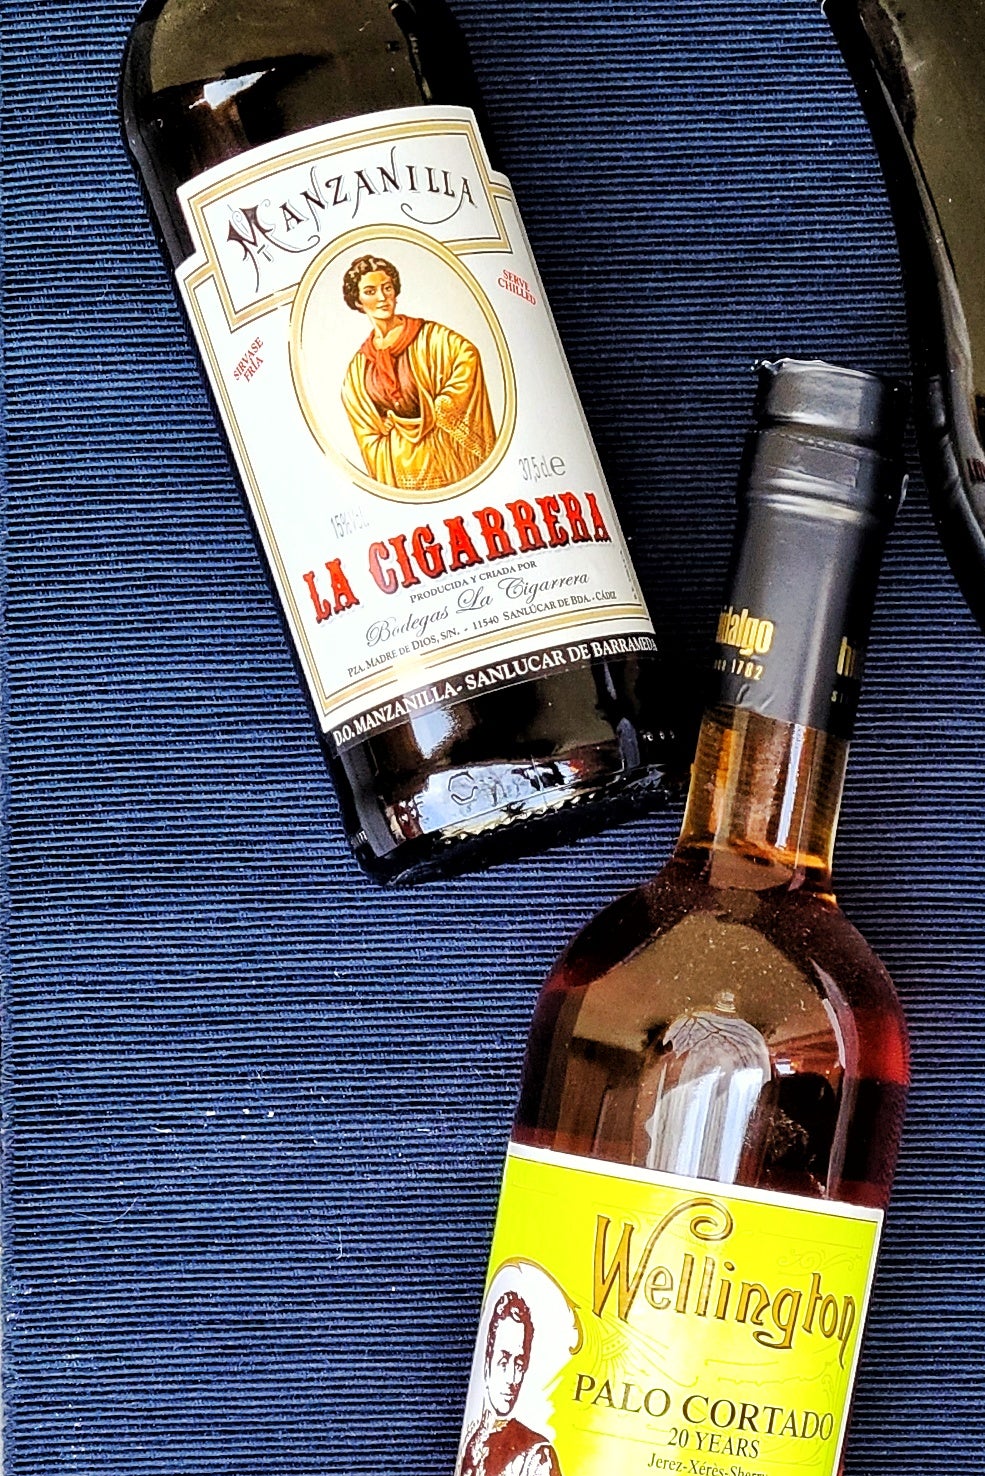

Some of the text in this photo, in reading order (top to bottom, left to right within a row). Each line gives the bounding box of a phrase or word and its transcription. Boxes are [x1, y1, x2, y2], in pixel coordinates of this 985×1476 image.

[226, 145, 478, 290] MANZANILLA
[498, 277, 537, 305] CHILLED
[503, 269, 531, 292] SERVE
[233, 336, 264, 381] SIRVASE
[302, 558, 361, 624] LA
[367, 491, 612, 595] CIGARRERA
[410, 559, 538, 603] PRODUCIDA Y CRIADA POR
[365, 649, 397, 669] MADRE
[411, 635, 440, 650] DIOS,
[472, 615, 500, 630] 11540
[502, 601, 557, 621] SANLÚCAR
[557, 597, 570, 608] DE
[366, 605, 449, 647] Bodegas
[455, 586, 493, 613] La
[498, 572, 590, 604] Cigarrera
[332, 725, 355, 747] D.O.
[465, 650, 568, 690] SANLUCAR
[567, 644, 592, 665] DE
[591, 636, 658, 658] BARRAMEDA
[731, 658, 764, 681] 1782
[592, 1198, 857, 1369] Wellington
[572, 1373, 834, 1441] PALO CORTADO
[667, 1427, 760, 1459] 20 YEARS
